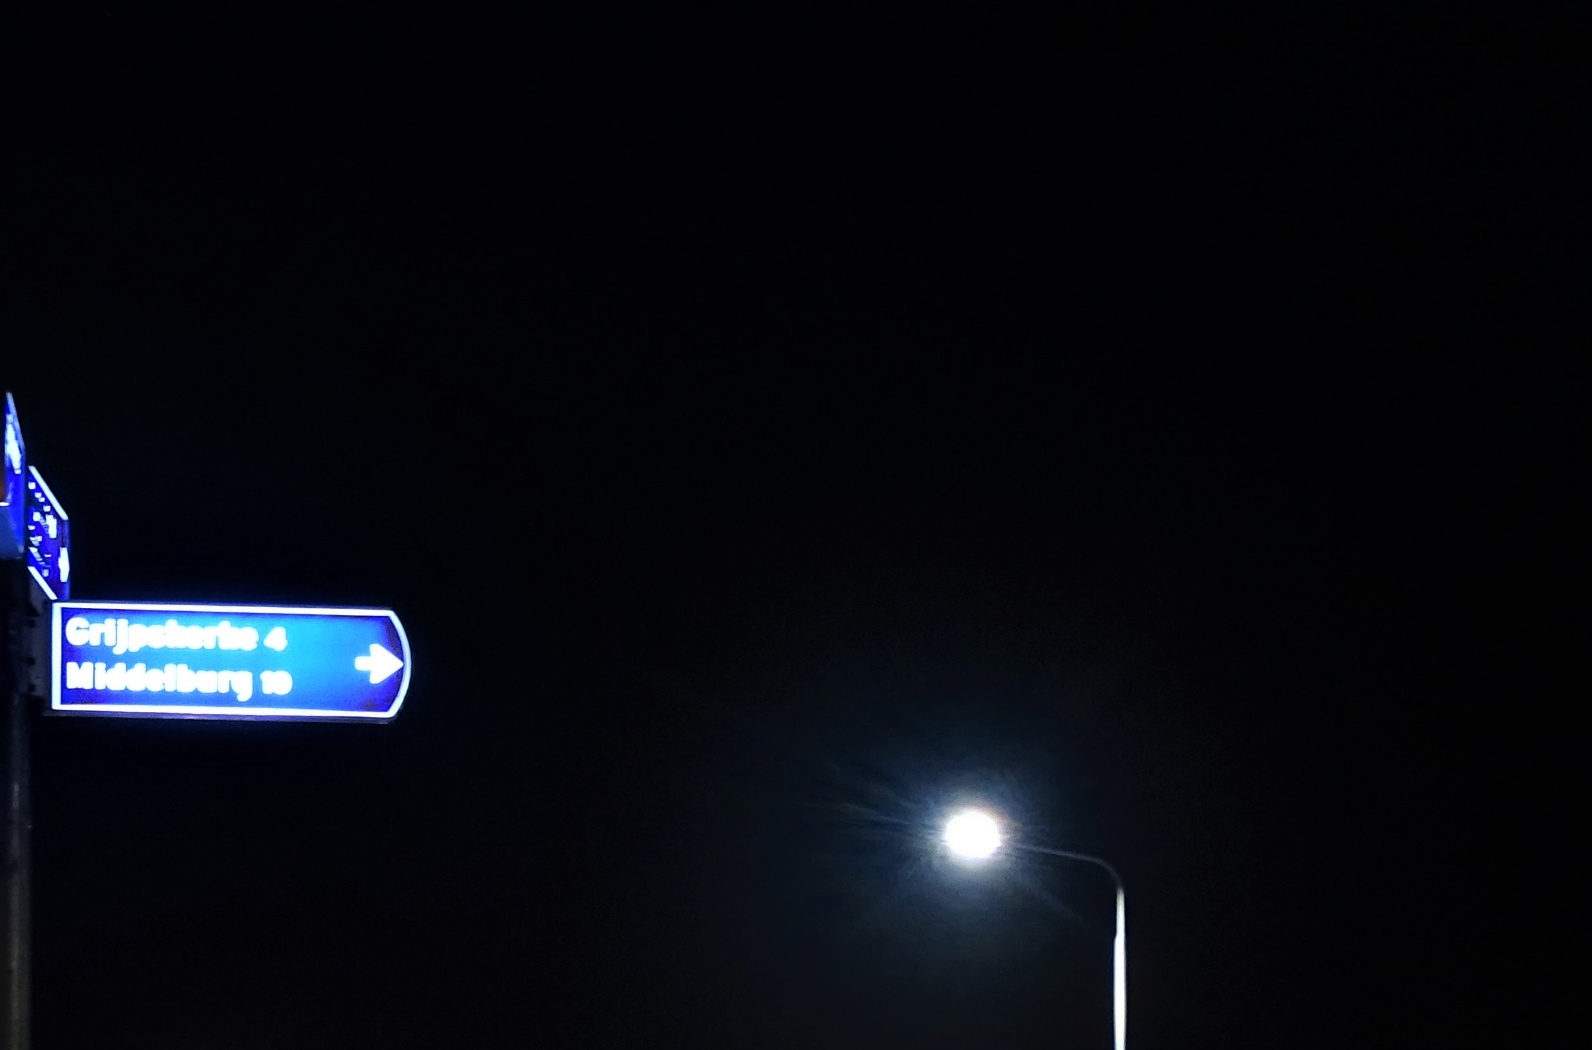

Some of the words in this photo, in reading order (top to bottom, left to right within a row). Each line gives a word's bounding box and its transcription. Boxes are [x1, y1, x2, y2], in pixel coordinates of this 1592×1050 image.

[65, 617, 258, 655] Grijpskerke
[264, 627, 287, 651] 4
[66, 662, 253, 702] Middelburg
